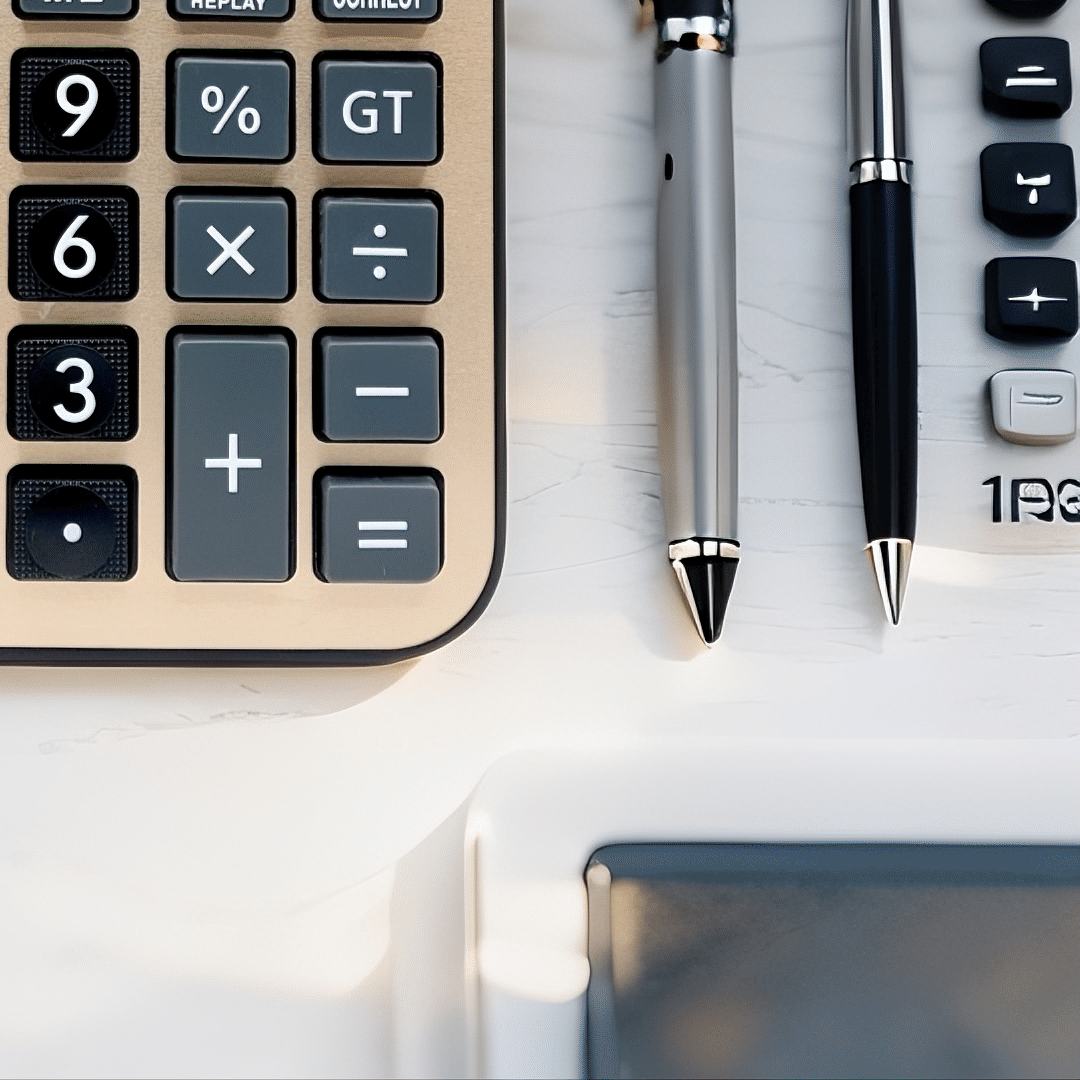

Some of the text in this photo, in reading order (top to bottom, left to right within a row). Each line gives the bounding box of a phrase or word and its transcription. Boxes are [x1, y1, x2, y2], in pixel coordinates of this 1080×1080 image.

[56, 74, 99, 137] 9
[342, 90, 413, 134] GT
[53, 215, 96, 279] 6
[53, 357, 96, 423] 3
